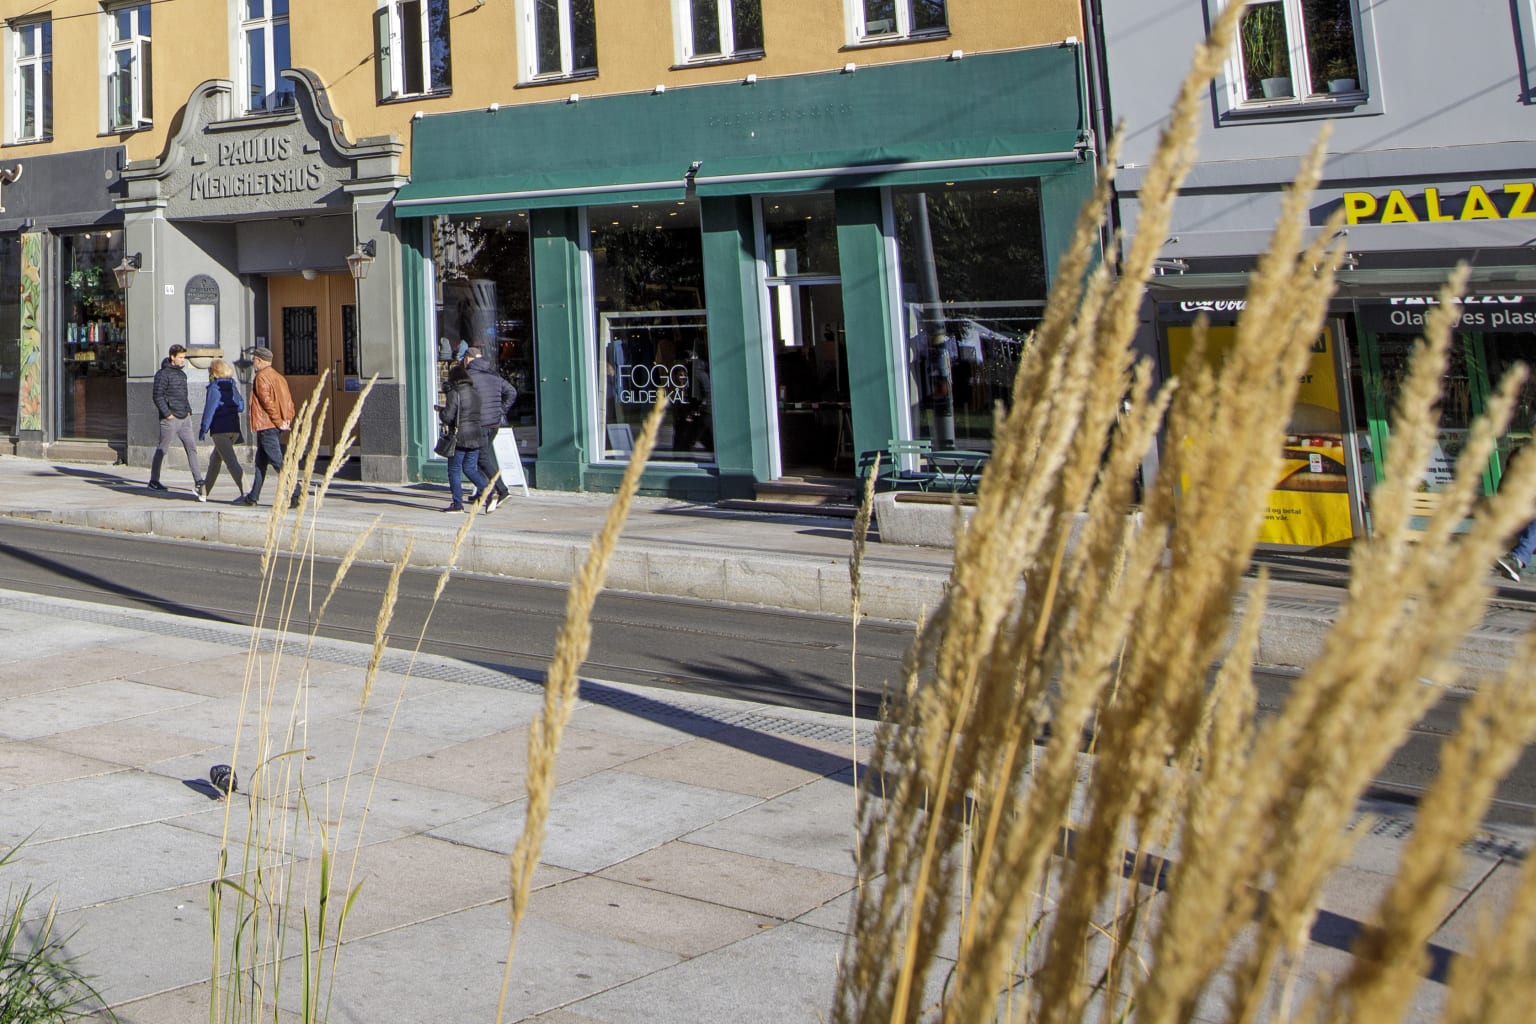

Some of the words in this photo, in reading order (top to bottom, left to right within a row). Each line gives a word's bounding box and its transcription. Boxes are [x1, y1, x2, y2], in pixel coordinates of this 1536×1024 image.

[219, 135, 292, 166] PAULUS
[191, 163, 324, 200] MENIGHETSHUS
[1491, 309, 1536, 327] plas
[618, 364, 689, 388] FOGG
[620, 388, 690, 404] GILDEKÅL
